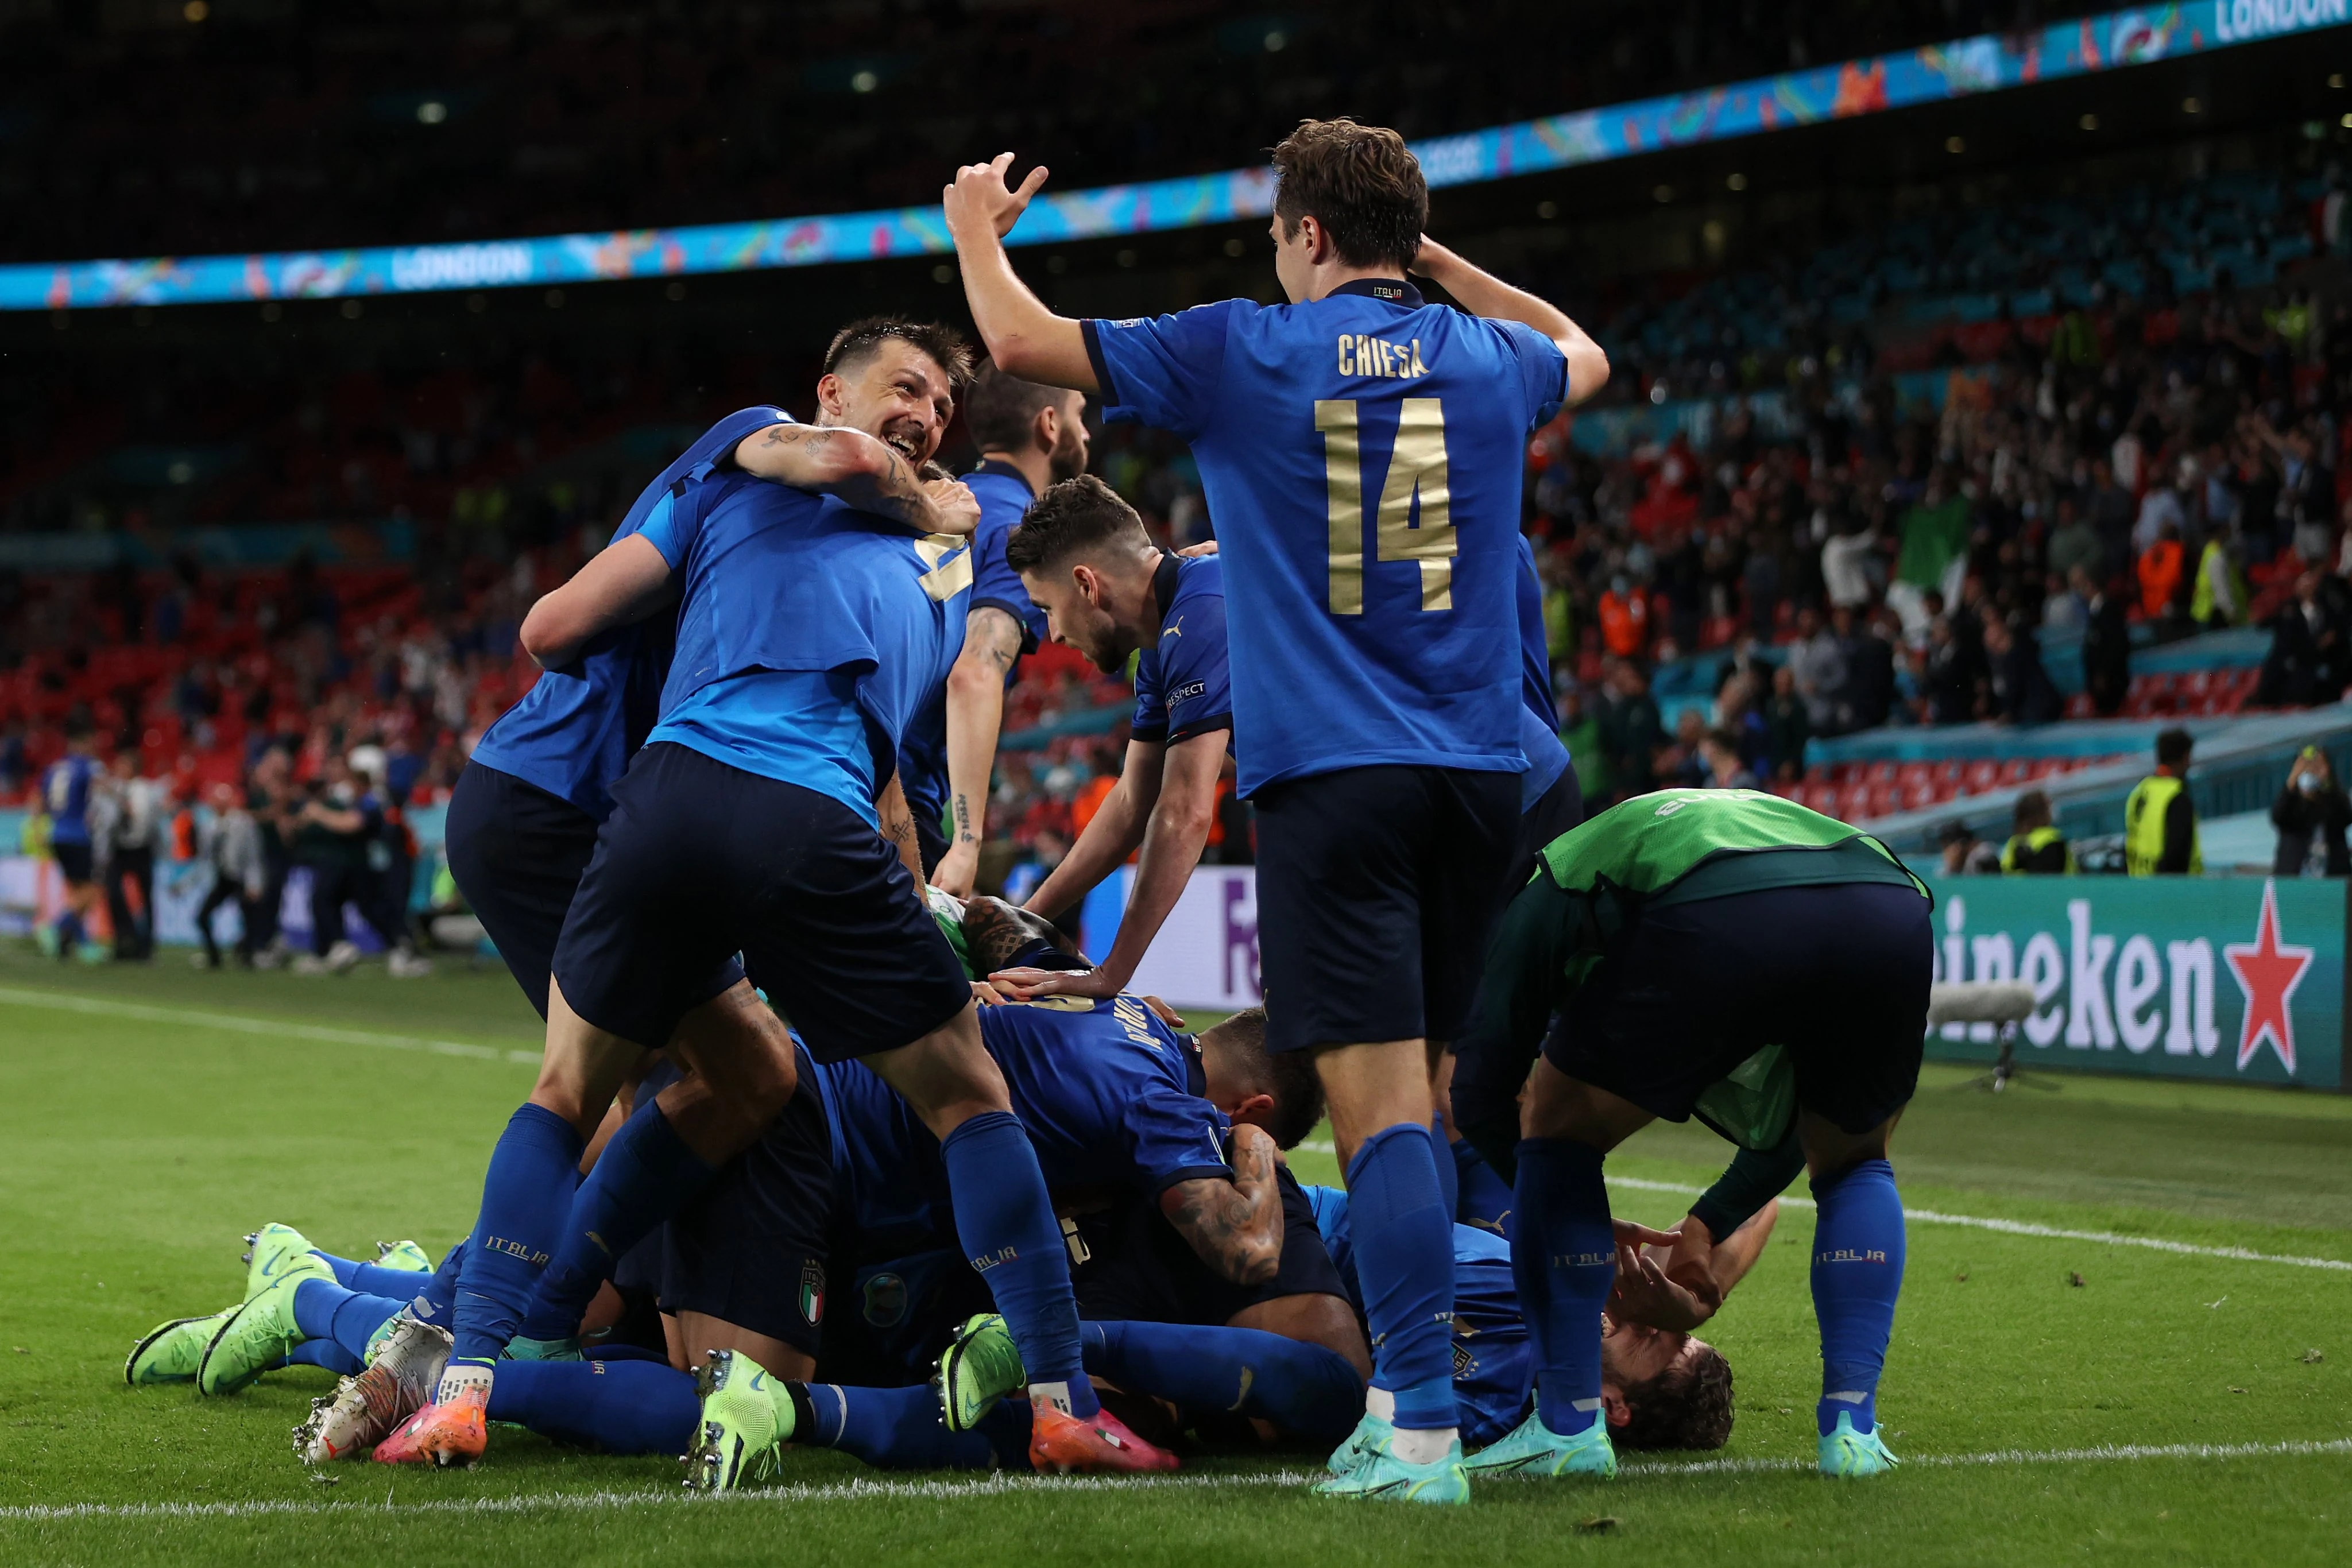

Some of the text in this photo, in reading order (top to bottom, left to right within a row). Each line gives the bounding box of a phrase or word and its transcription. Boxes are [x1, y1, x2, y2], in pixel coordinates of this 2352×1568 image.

[393, 244, 533, 289] LONDON
[1374, 287, 1402, 297] ITALIA
[1339, 334, 1430, 379] CHIESA
[1314, 398, 1457, 615] 14
[1168, 683, 1205, 709] RESPECT
[1925, 894, 2221, 1058] ineken
[485, 1236, 549, 1265] ITALIA
[1816, 1249, 1885, 1265] ITALIA
